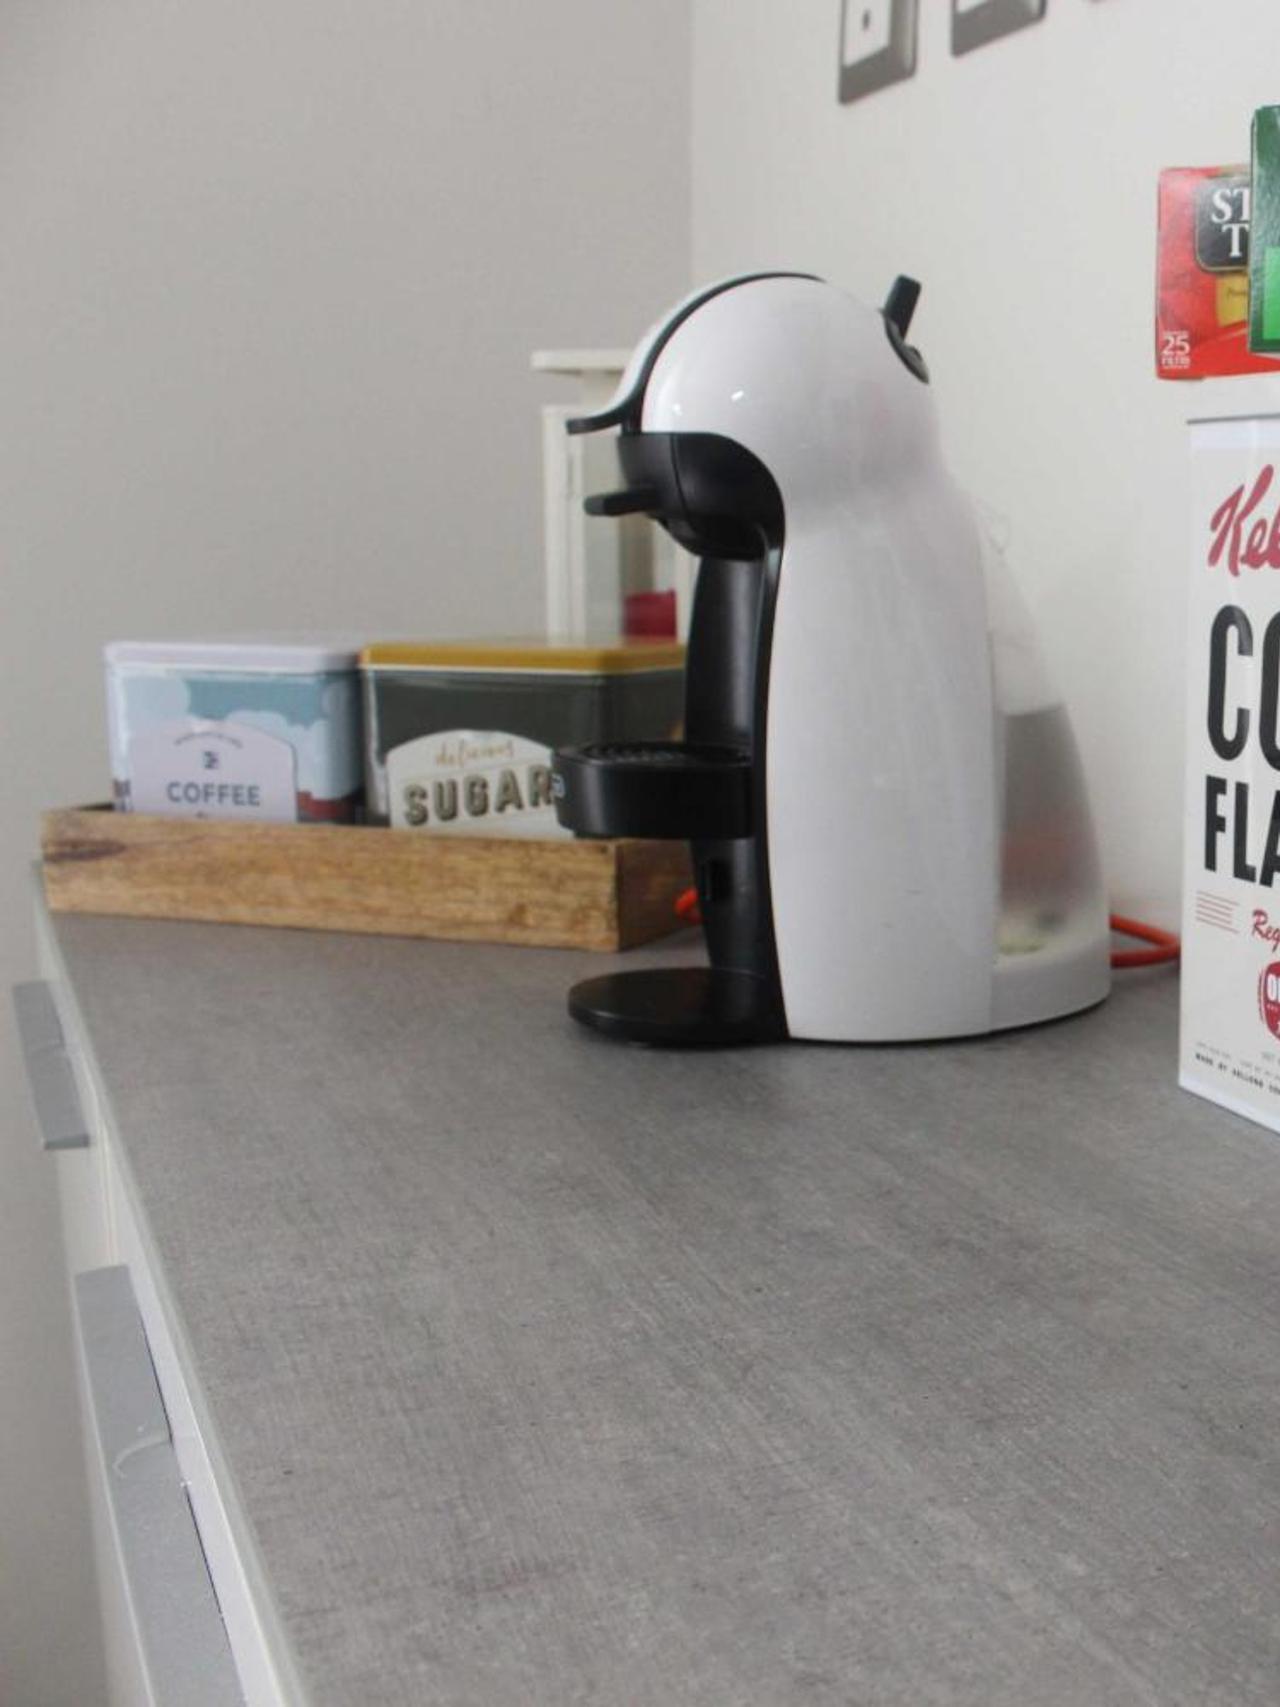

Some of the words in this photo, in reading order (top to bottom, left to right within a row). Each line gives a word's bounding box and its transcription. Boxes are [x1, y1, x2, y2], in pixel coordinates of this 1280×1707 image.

[1211, 187, 1249, 223] ST
[1162, 332, 1190, 355] 25
[167, 781, 260, 806] COFFEE
[404, 763, 553, 826] SUGAR
